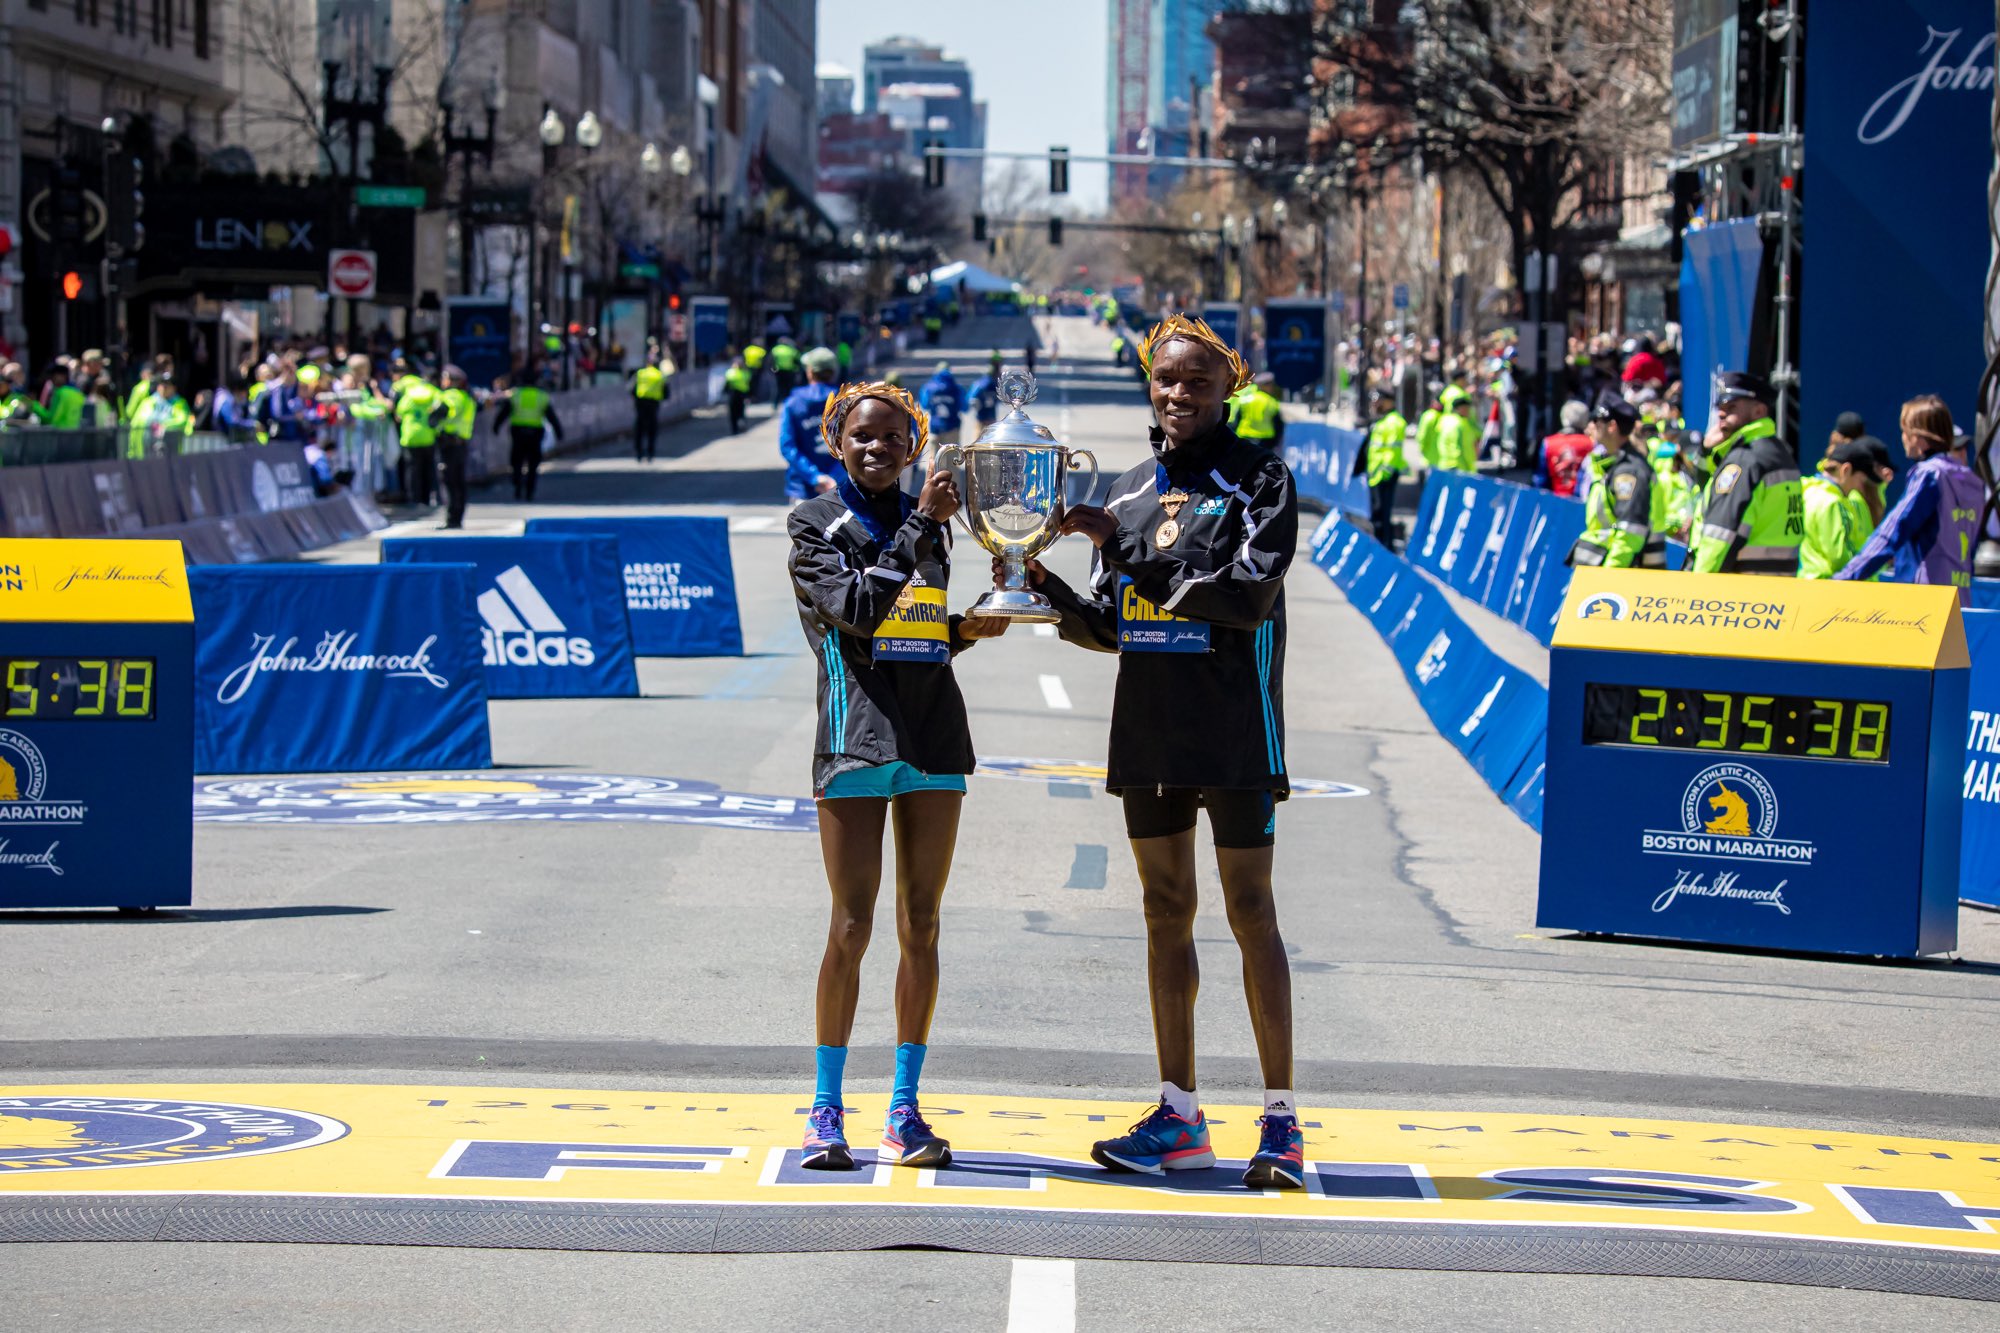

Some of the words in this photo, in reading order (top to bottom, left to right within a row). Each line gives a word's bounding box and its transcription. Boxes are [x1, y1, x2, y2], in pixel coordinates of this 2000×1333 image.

[53, 564, 99, 593] John
[101, 564, 174, 589] Hancock
[623, 563, 681, 575] ABBOTT
[624, 574, 679, 586] WORLD
[625, 585, 714, 598] MARATHON
[627, 597, 691, 610] MAJORS
[1689, 599, 1785, 615] BOSTON
[1807, 607, 1860, 634] John
[1859, 608, 1931, 636] Hancock
[216, 632, 308, 704] John
[304, 629, 449, 689] Hancock
[1630, 688, 1888, 759] 2:35:38
[9, 735, 42, 796] ASSOCIATION
[1686, 785, 1701, 828] BOSTON
[1698, 766, 1743, 788] ATHLETIC
[1743, 771, 1774, 834] ASSOCIATION
[1642, 834, 1712, 852] BOSTON
[1651, 868, 1708, 913] John
[1706, 870, 1792, 915] Hancock
[416, 1099, 728, 1113] 126TH
